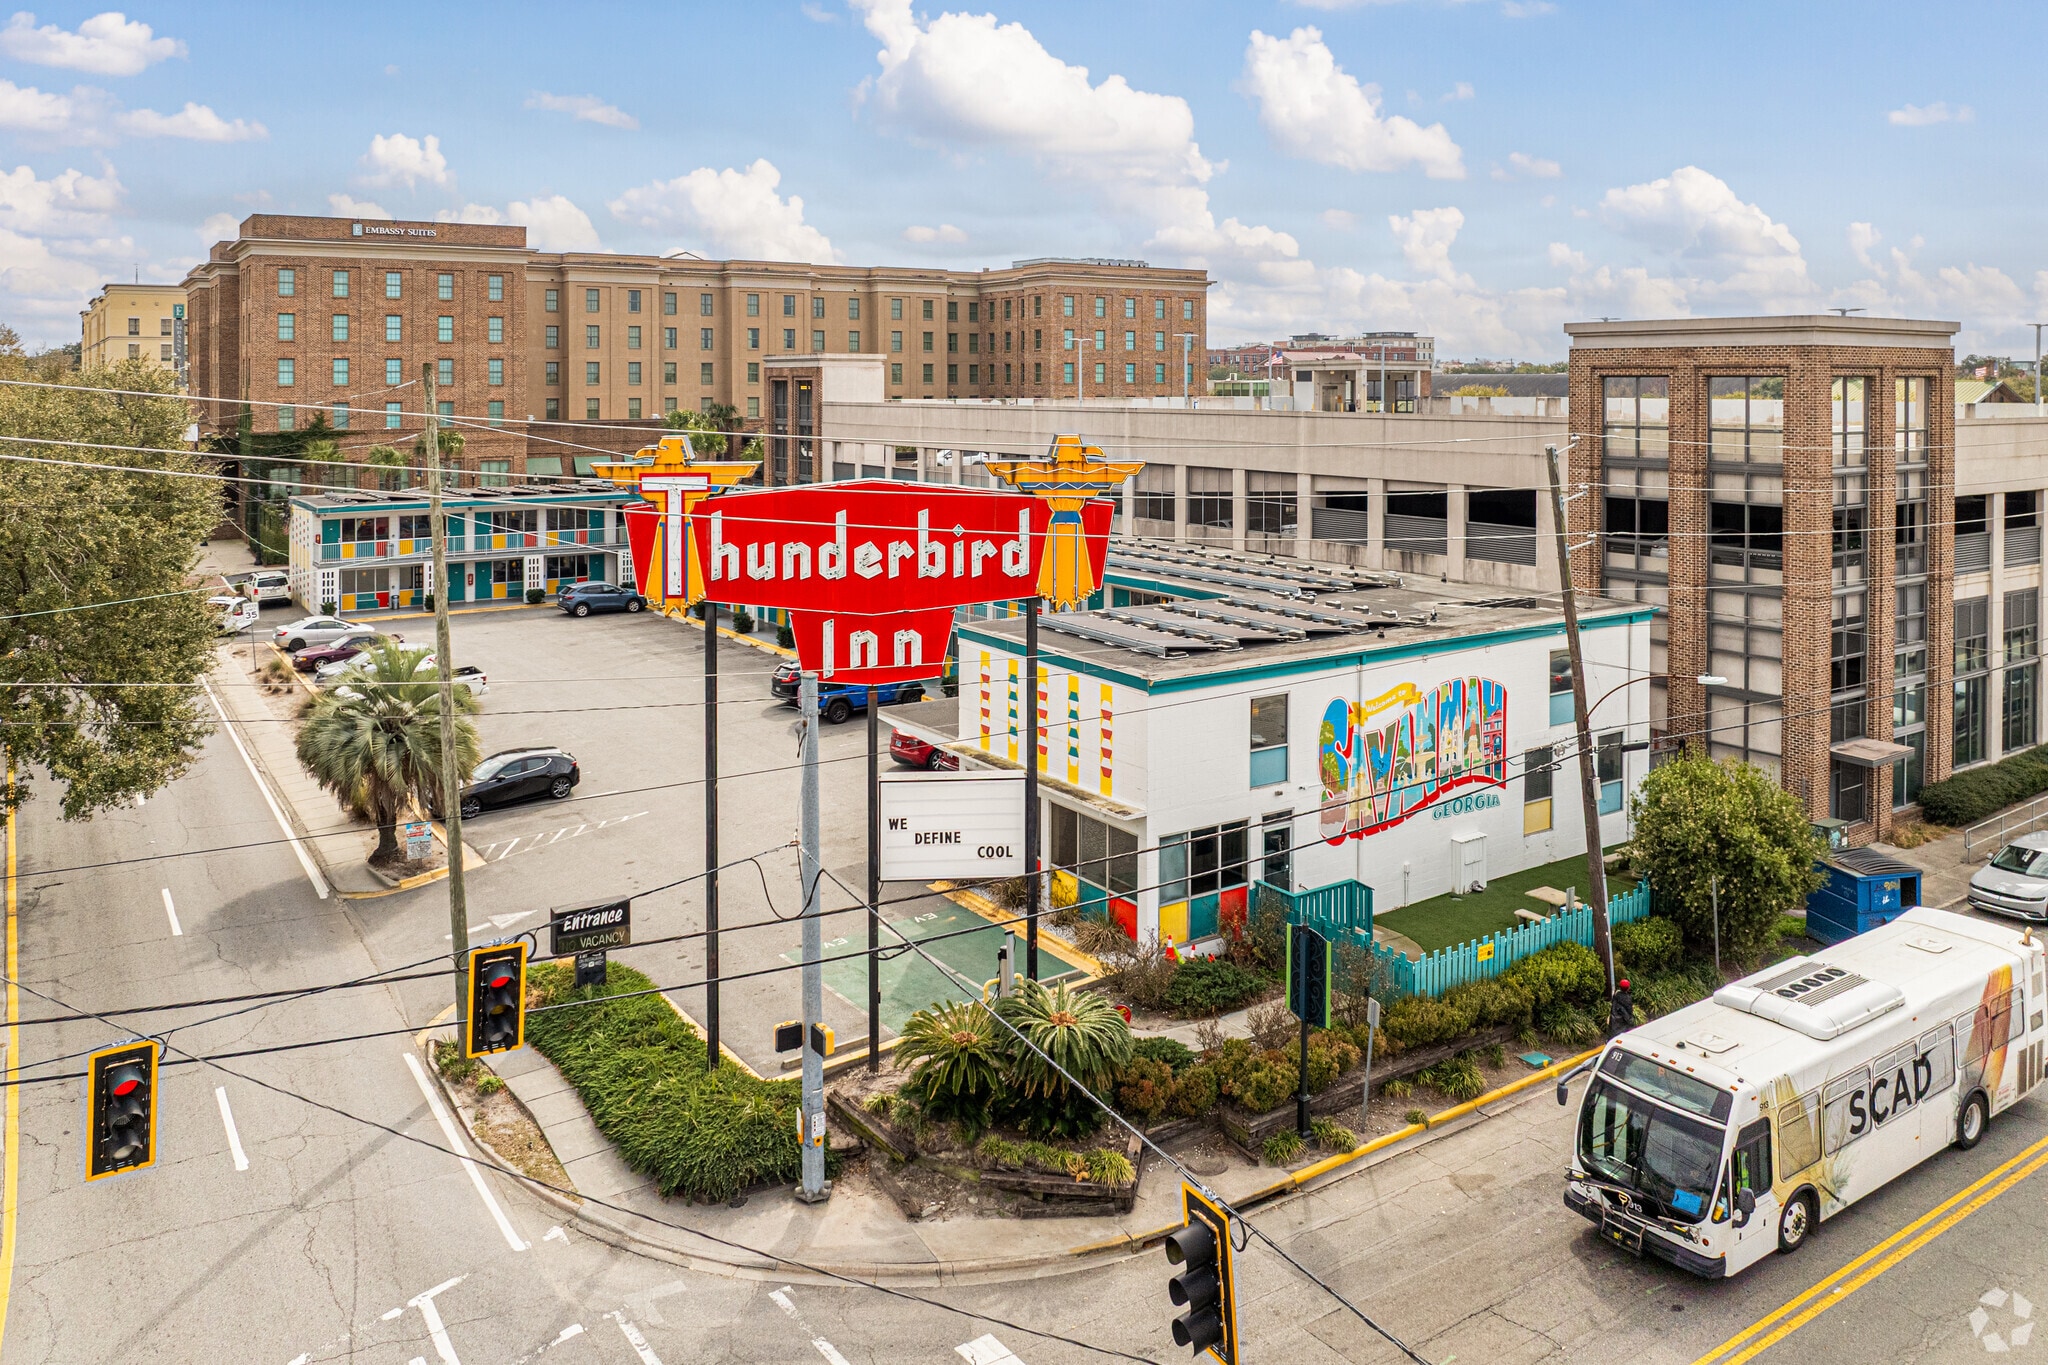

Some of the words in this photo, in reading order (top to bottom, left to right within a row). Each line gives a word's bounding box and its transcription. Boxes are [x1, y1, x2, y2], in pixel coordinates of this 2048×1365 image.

[365, 227, 405, 235] EMBASSY
[640, 474, 1030, 597] Thunderbird
[245, 611, 257, 619] 35
[823, 618, 923, 679] Inn
[1365, 694, 1397, 713] Welcome
[1397, 689, 1407, 698] to
[1318, 676, 1508, 847] SAVANNAH
[1432, 793, 1501, 821] GEORGIA
[888, 818, 908, 831] WE
[914, 831, 962, 845] DEFINE
[977, 845, 1013, 858] COOL
[563, 908, 623, 932] Entrance
[580, 930, 625, 948] VACANCY
[1611, 1051, 1623, 1062] 913
[1849, 1054, 1932, 1135] SCAD
[1759, 1100, 1769, 1112] 913
